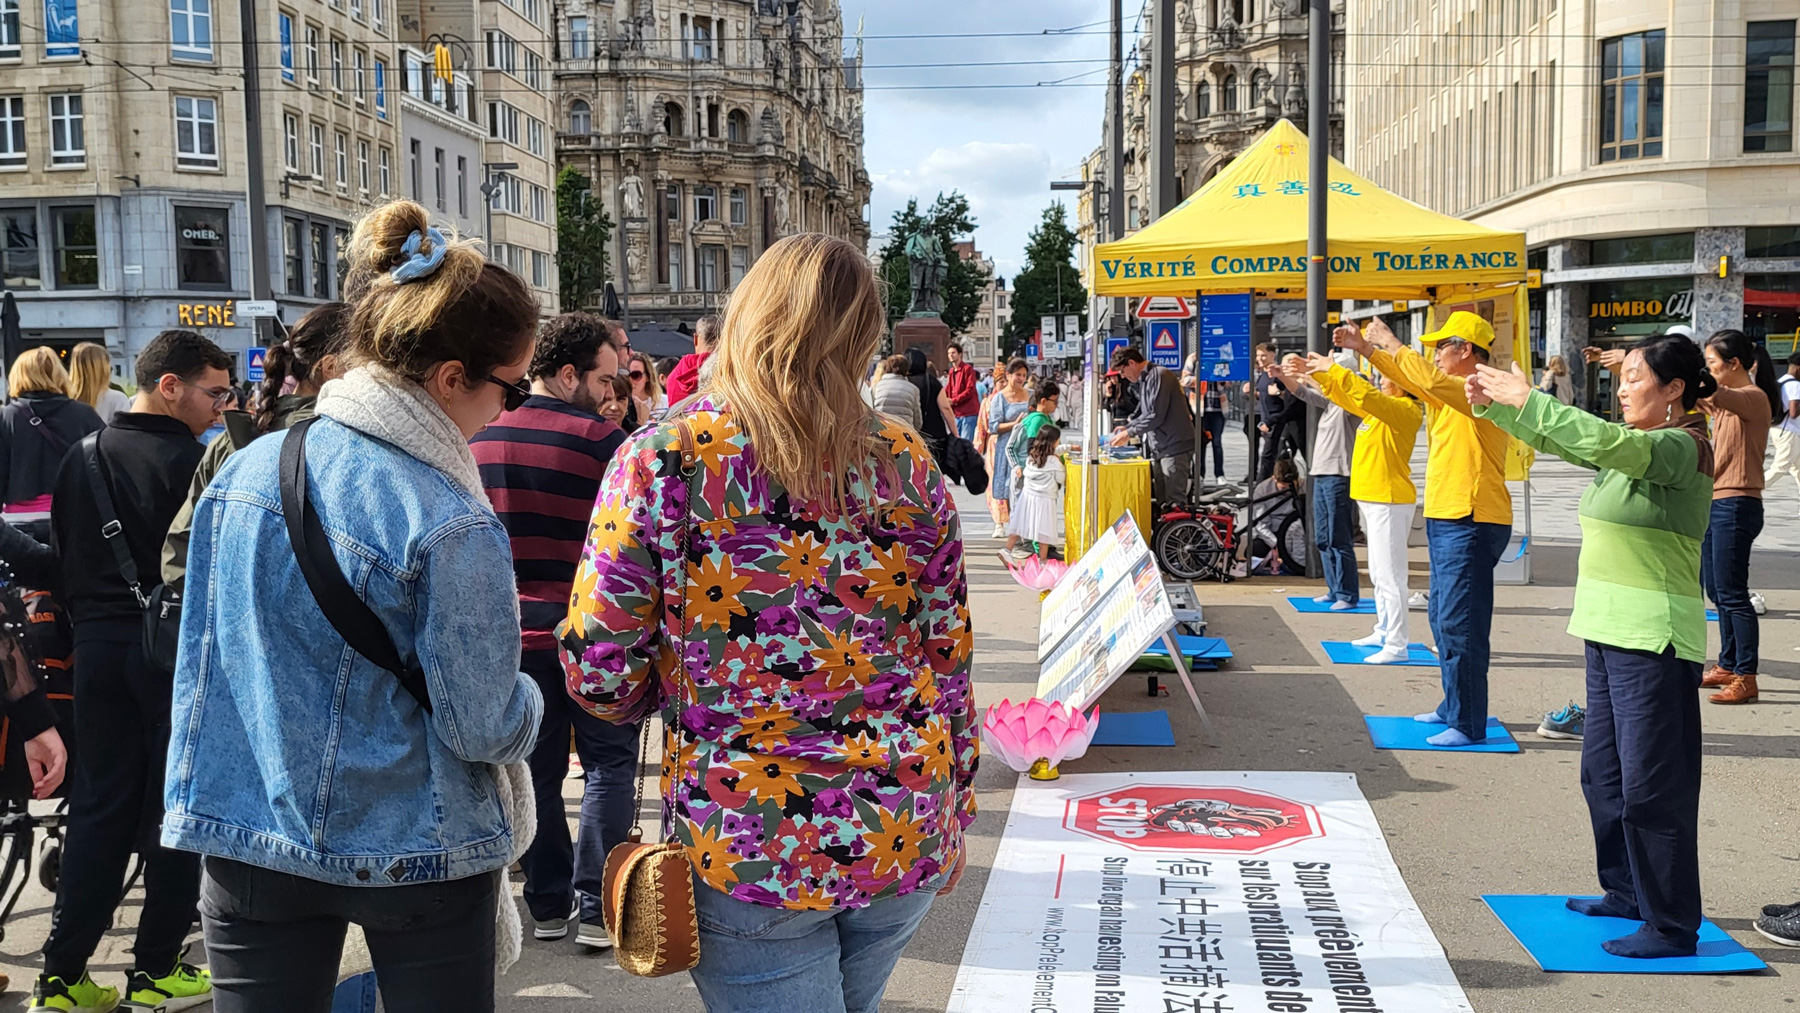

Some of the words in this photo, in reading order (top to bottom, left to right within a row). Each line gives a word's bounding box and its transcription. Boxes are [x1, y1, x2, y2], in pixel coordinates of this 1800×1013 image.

[1101, 254, 1196, 279] VÉRITÉ
[1211, 255, 1361, 275] COMPASON
[1373, 246, 1518, 271] TOLÉRANCE
[178, 300, 236, 327] RENÉ
[1589, 299, 1663, 318] JUMBO
[1153, 357, 1178, 366] TRAM
[1096, 797, 1148, 838] STOP
[1100, 857, 1128, 876] Stop
[1238, 859, 1268, 880] sur
[1293, 862, 1331, 888] Stop
[1102, 877, 1128, 892] live
[1243, 882, 1280, 900] les
[1097, 893, 1124, 918] organ
[1301, 890, 1341, 912] aux
[1304, 915, 1384, 1013] préèvement
[1095, 974, 1121, 987] on
[1265, 991, 1313, 1013] de
